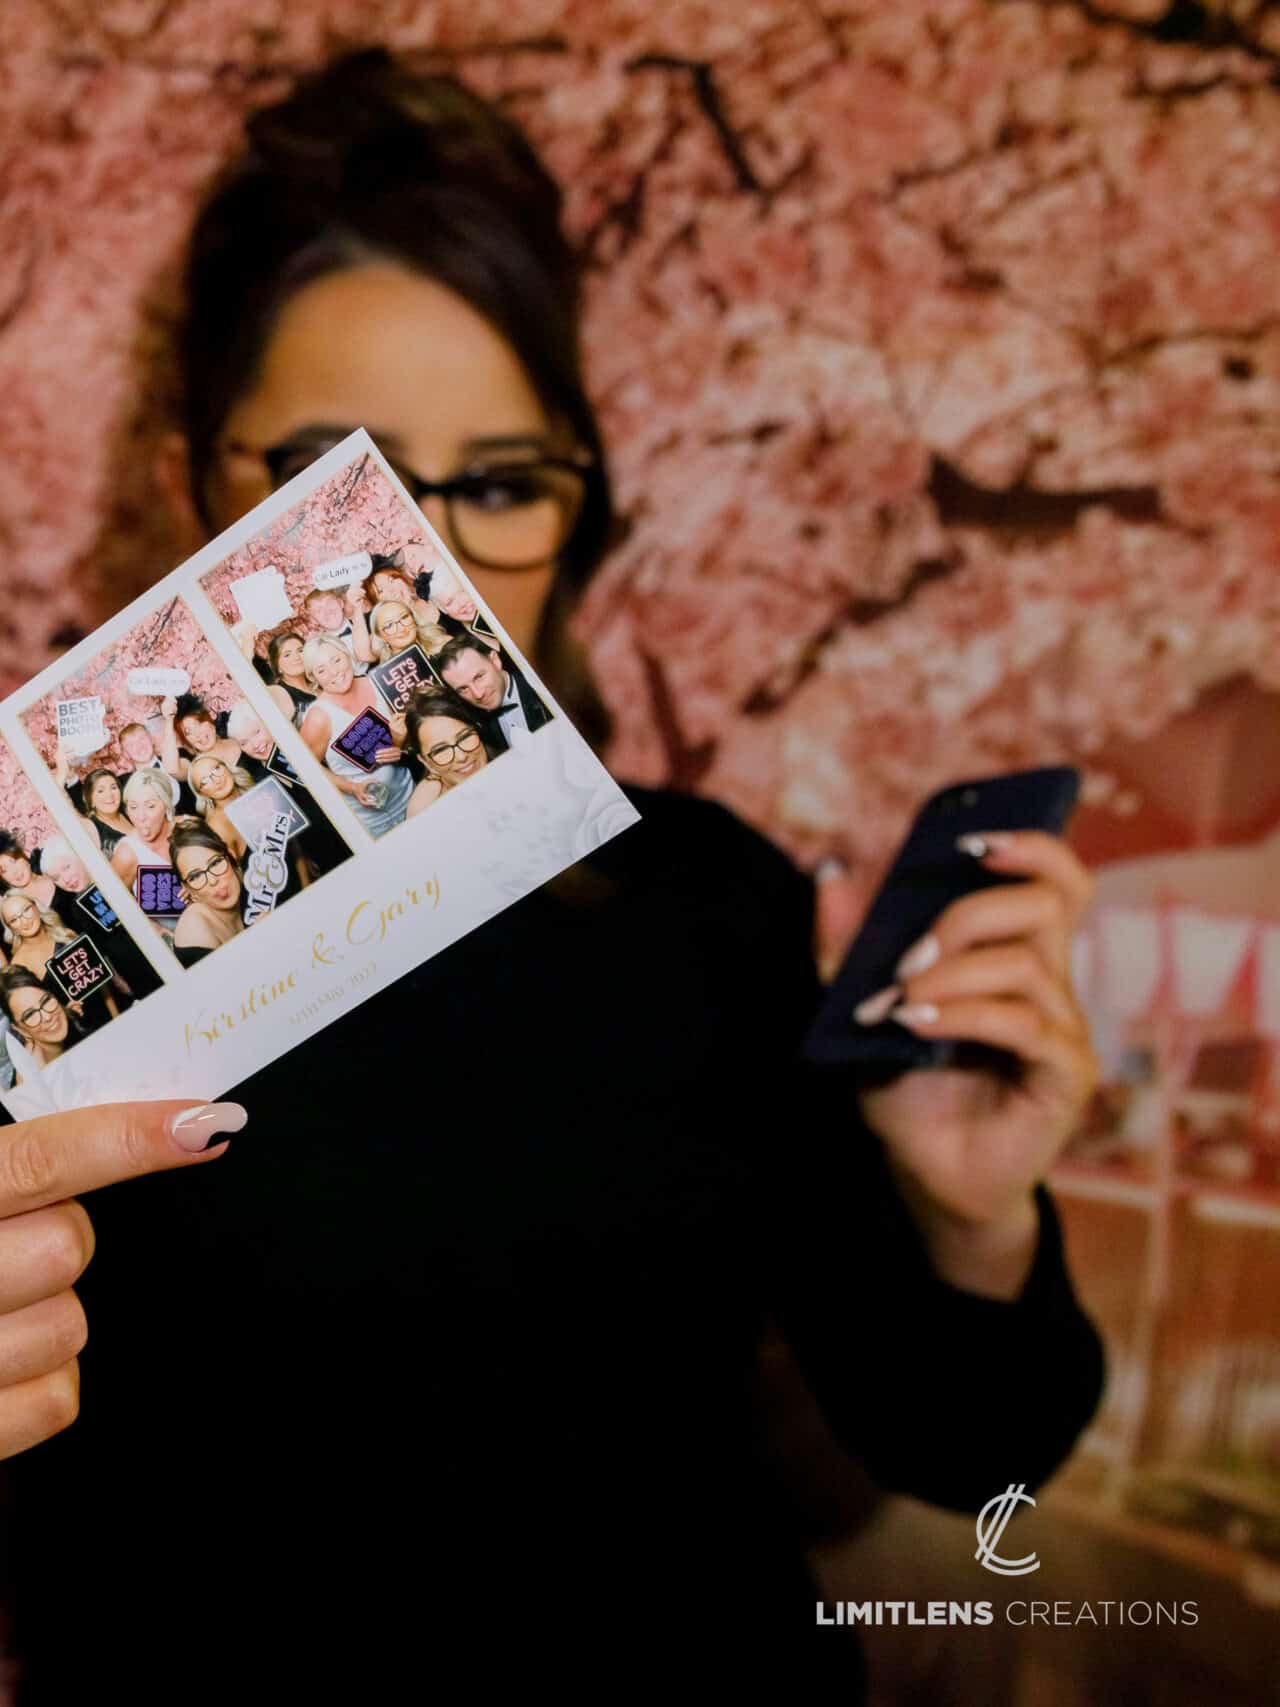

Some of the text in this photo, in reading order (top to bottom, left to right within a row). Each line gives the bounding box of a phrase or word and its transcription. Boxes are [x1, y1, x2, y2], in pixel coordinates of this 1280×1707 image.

[383, 656, 417, 686] LET'S
[396, 669, 421, 694] GET
[58, 700, 98, 716] BEST
[394, 676, 434, 710] CRZY
[263, 815, 289, 863] Mrs
[55, 947, 88, 975] LET'S
[311, 932, 345, 970] &
[67, 960, 90, 981] GET
[67, 963, 105, 998] CRAZY
